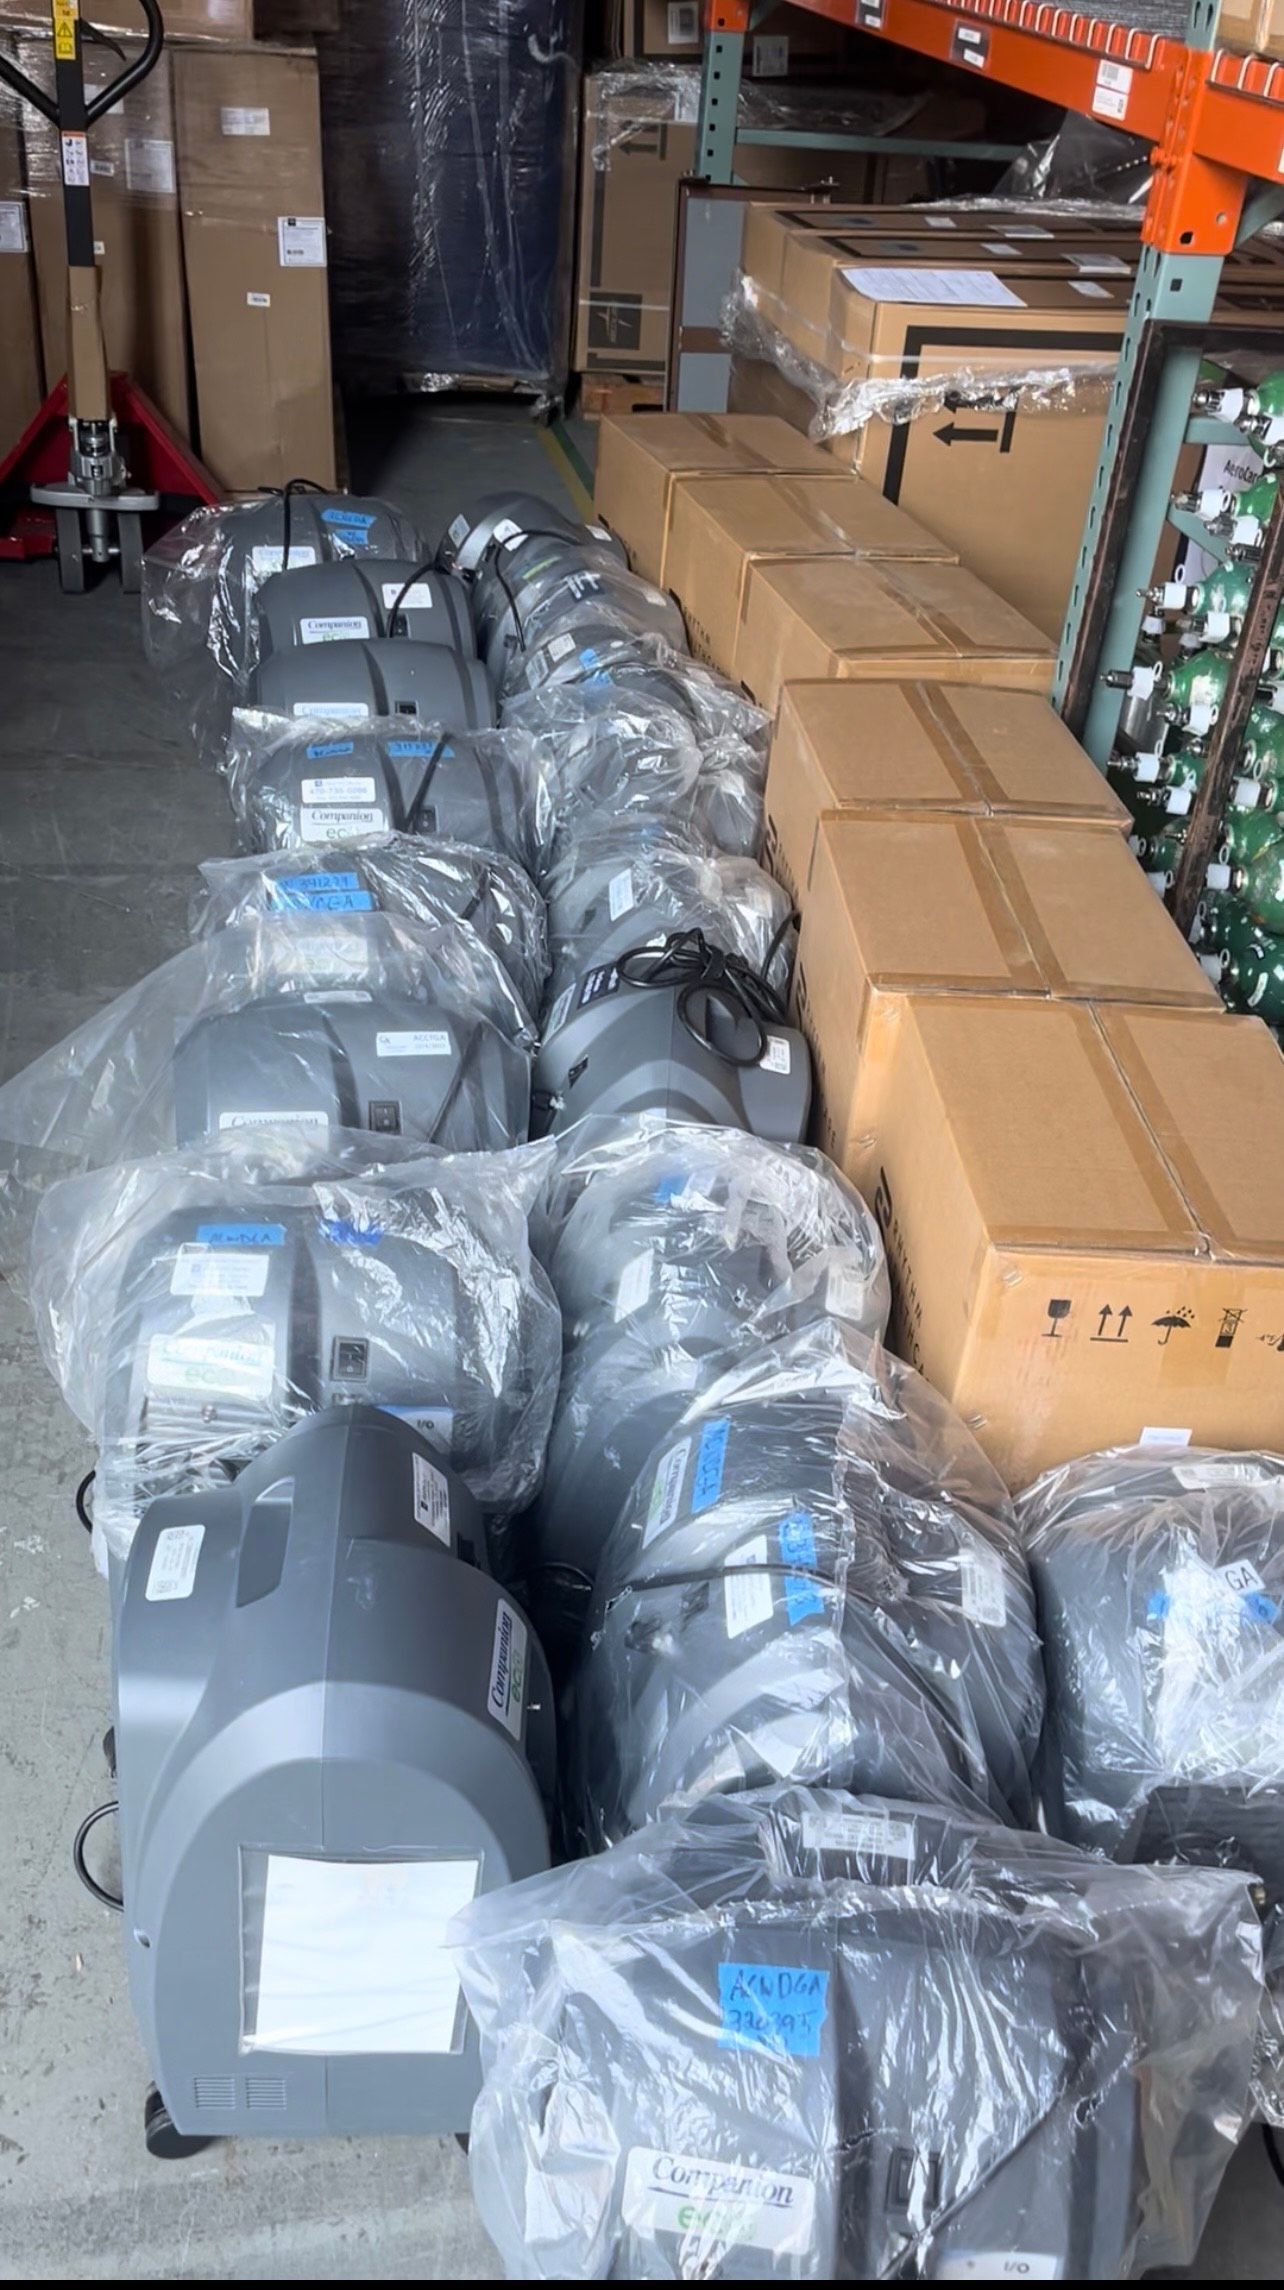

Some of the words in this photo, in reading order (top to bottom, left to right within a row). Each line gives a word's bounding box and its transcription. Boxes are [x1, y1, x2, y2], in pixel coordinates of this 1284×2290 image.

[307, 620, 362, 632] Companion
[311, 810, 373, 823] Companion
[491, 1611, 513, 1708] Companion
[652, 2156, 794, 2204] Companion
